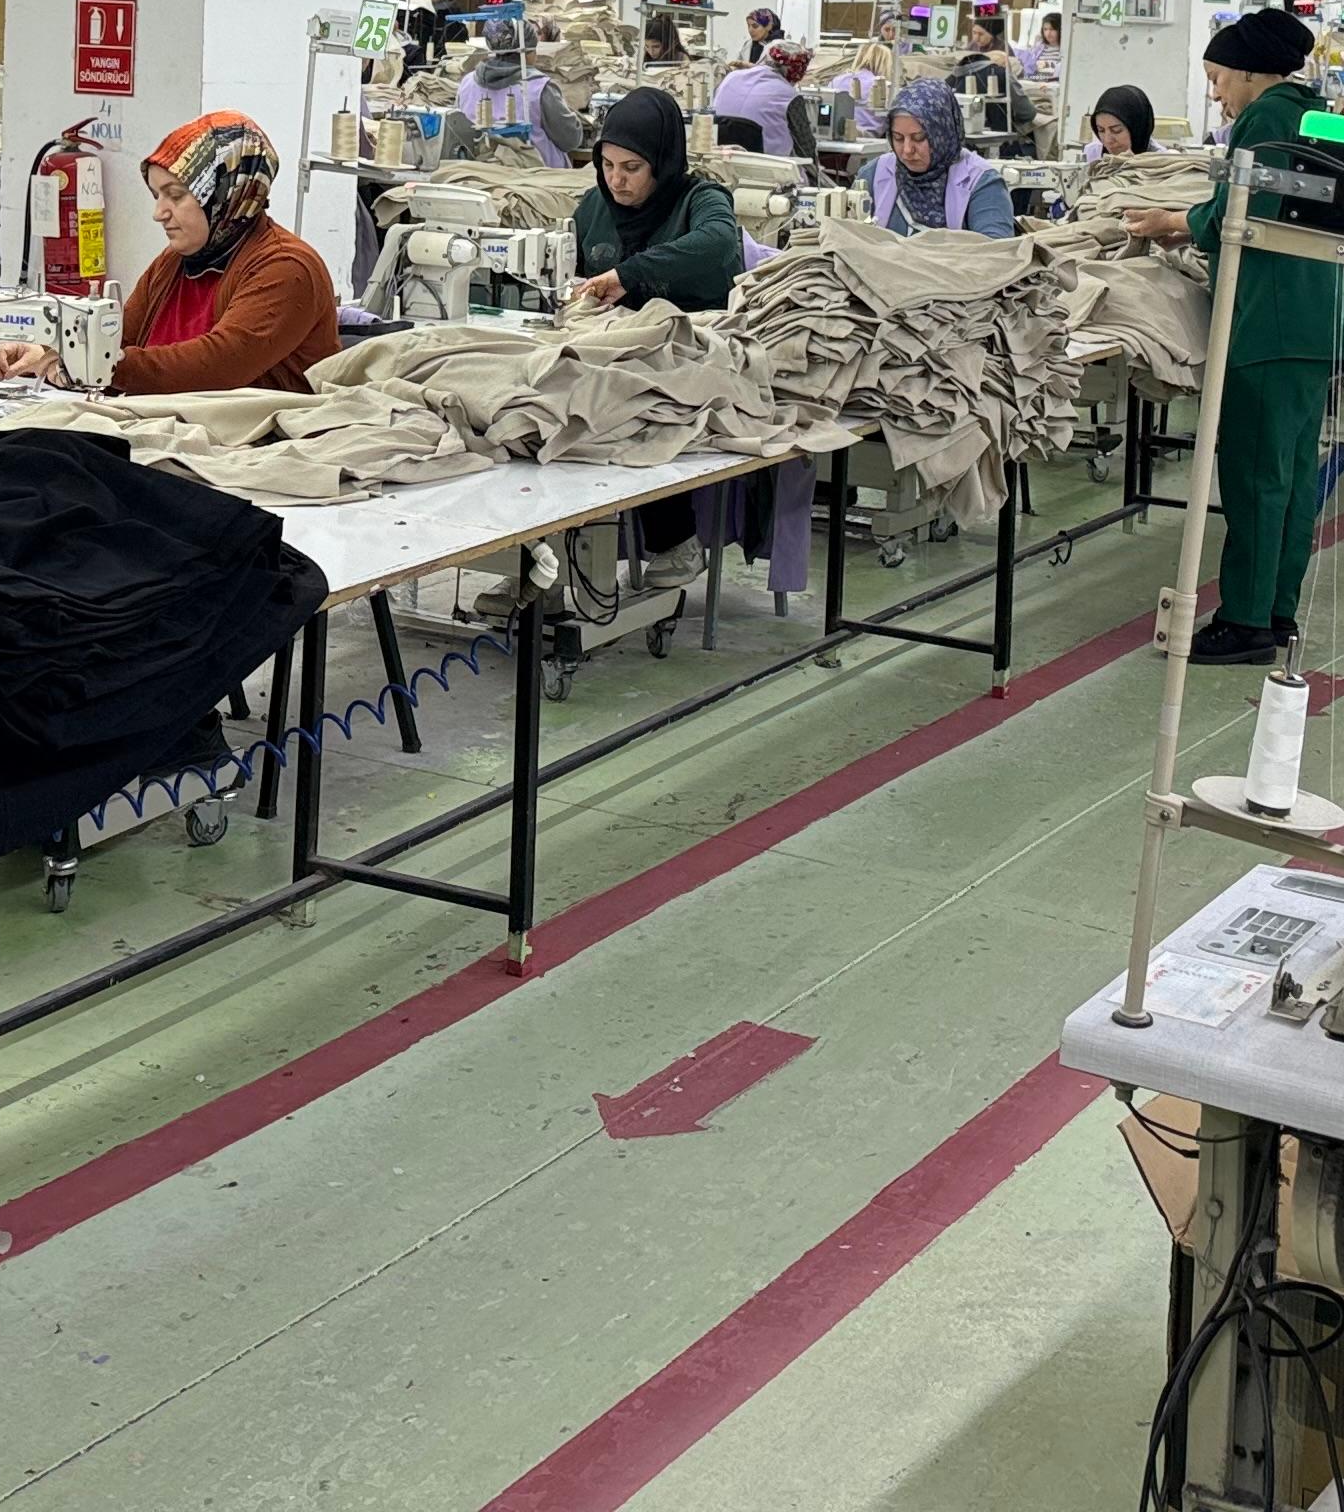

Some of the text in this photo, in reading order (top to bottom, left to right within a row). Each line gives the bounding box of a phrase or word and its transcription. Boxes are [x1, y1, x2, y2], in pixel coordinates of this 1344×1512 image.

[1101, 0, 1123, 22] 24
[354, 15, 390, 51] 25
[936, 15, 949, 40] 9
[89, 56, 121, 70] YANGIN
[79, 70, 130, 85] SÖNDÜRÜCÜ
[483, 245, 509, 254] JUK
[0, 314, 36, 326] JUKI
